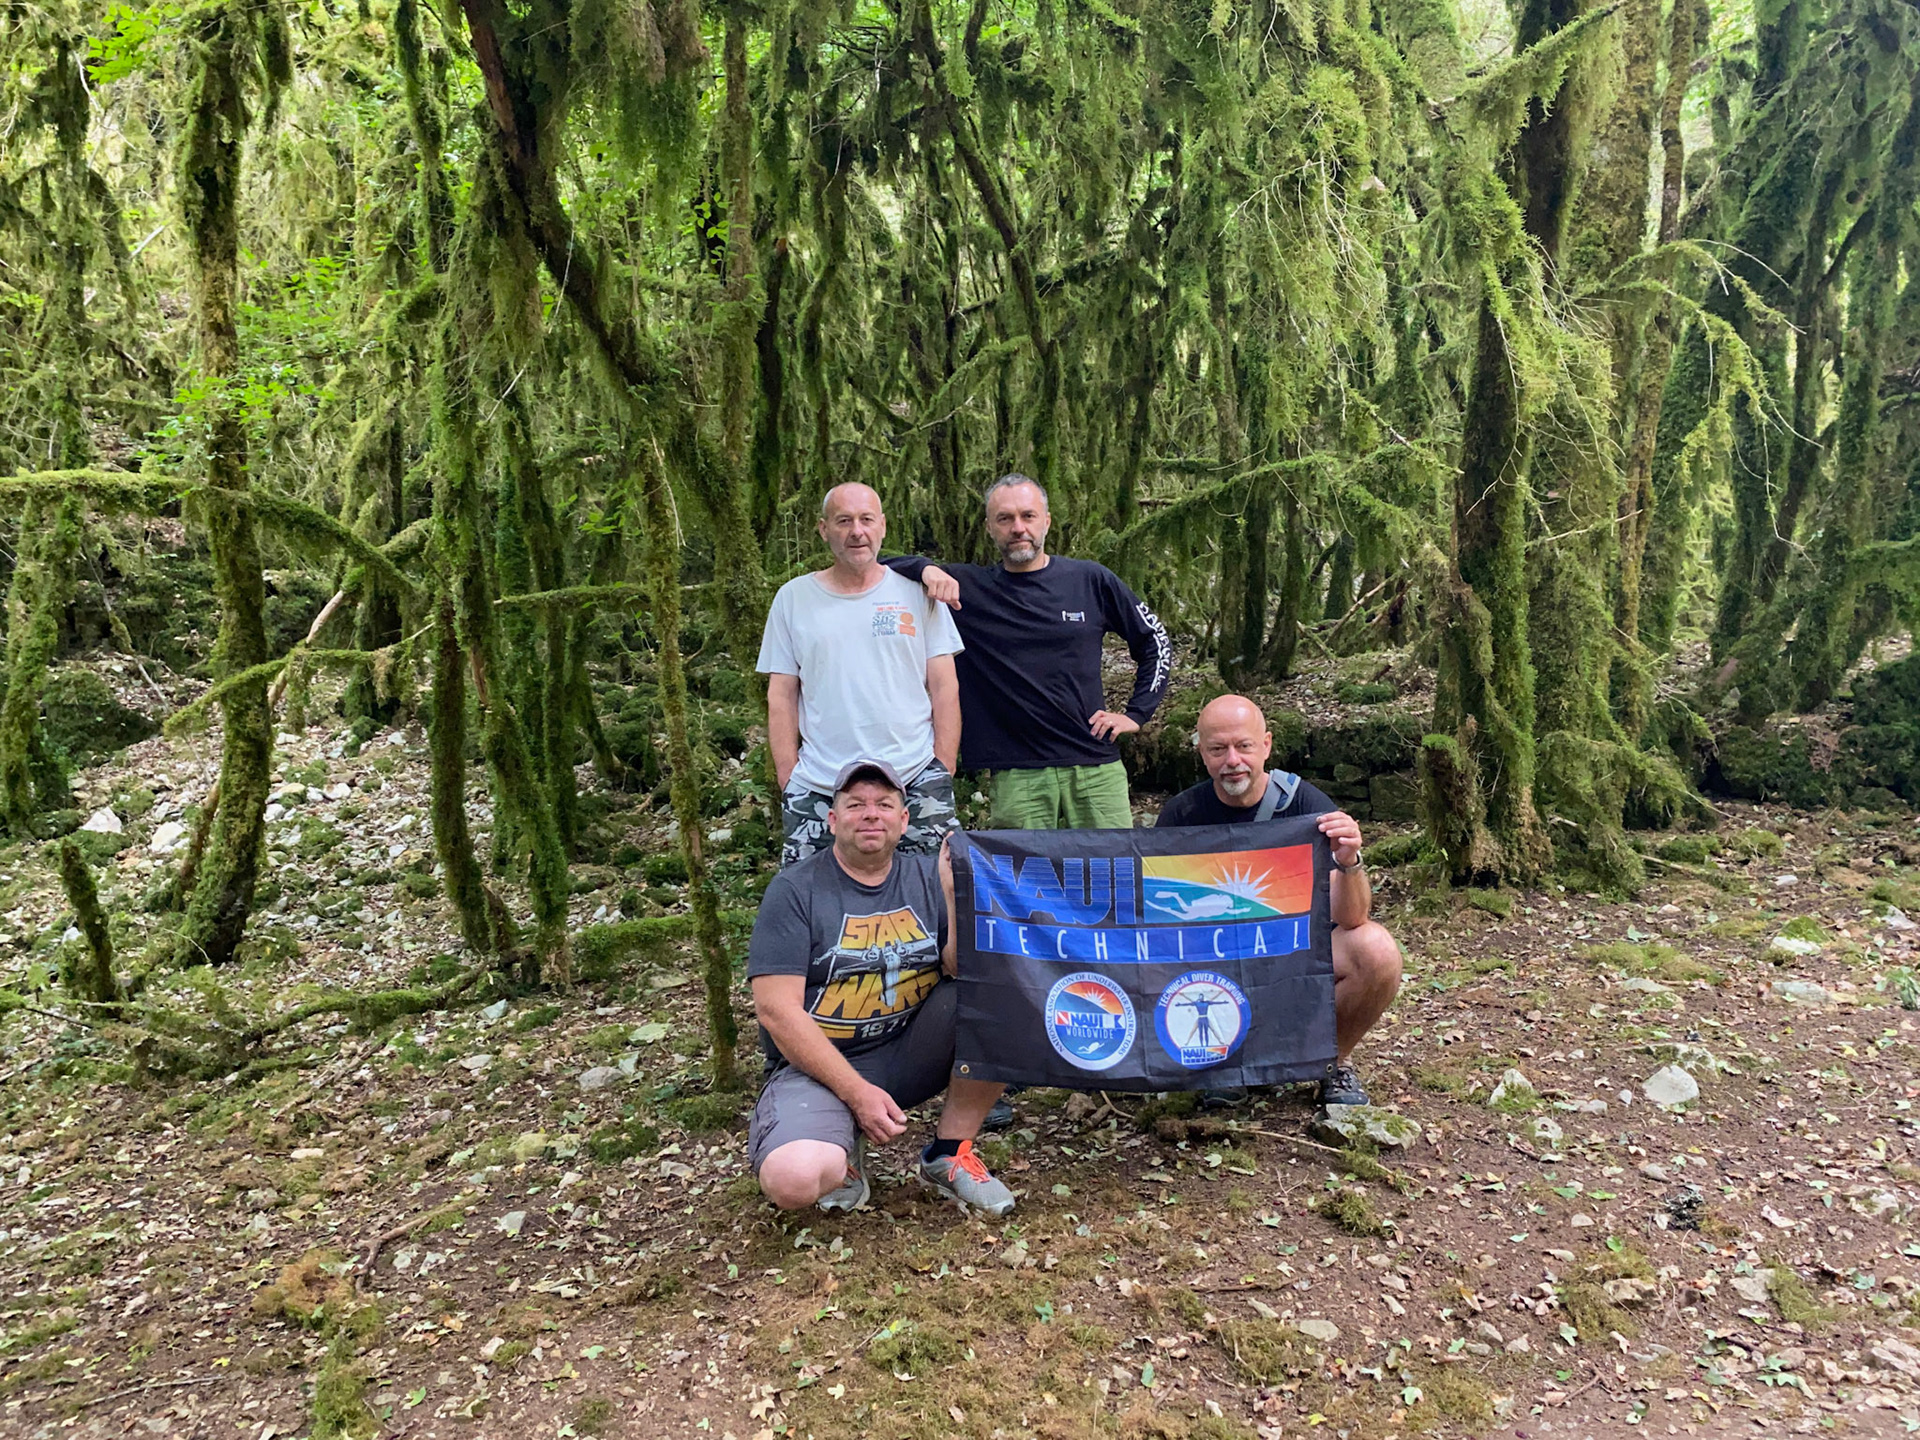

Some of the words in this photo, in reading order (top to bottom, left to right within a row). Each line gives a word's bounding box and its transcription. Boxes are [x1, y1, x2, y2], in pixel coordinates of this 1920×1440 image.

[969, 846, 1137, 925] NAUI
[840, 910, 928, 949] STAR
[985, 919, 1299, 961] TECHNICAL
[1075, 973, 1086, 981] OF
[1087, 974, 1128, 1006] UNDERWATER
[1158, 975, 1191, 1007] TECHNICAL
[1191, 973, 1215, 982] DIVER
[1215, 975, 1246, 1006] TRAINING
[1047, 976, 1074, 1014] ASSOCIATION
[1047, 1016, 1064, 1052] NATIONAL
[1065, 1027, 1114, 1039] WORLDWIDE
[1070, 1013, 1103, 1028] NAUI
[1118, 1006, 1134, 1056] INSTRUCTORS
[1183, 1049, 1205, 1058] NAUI
